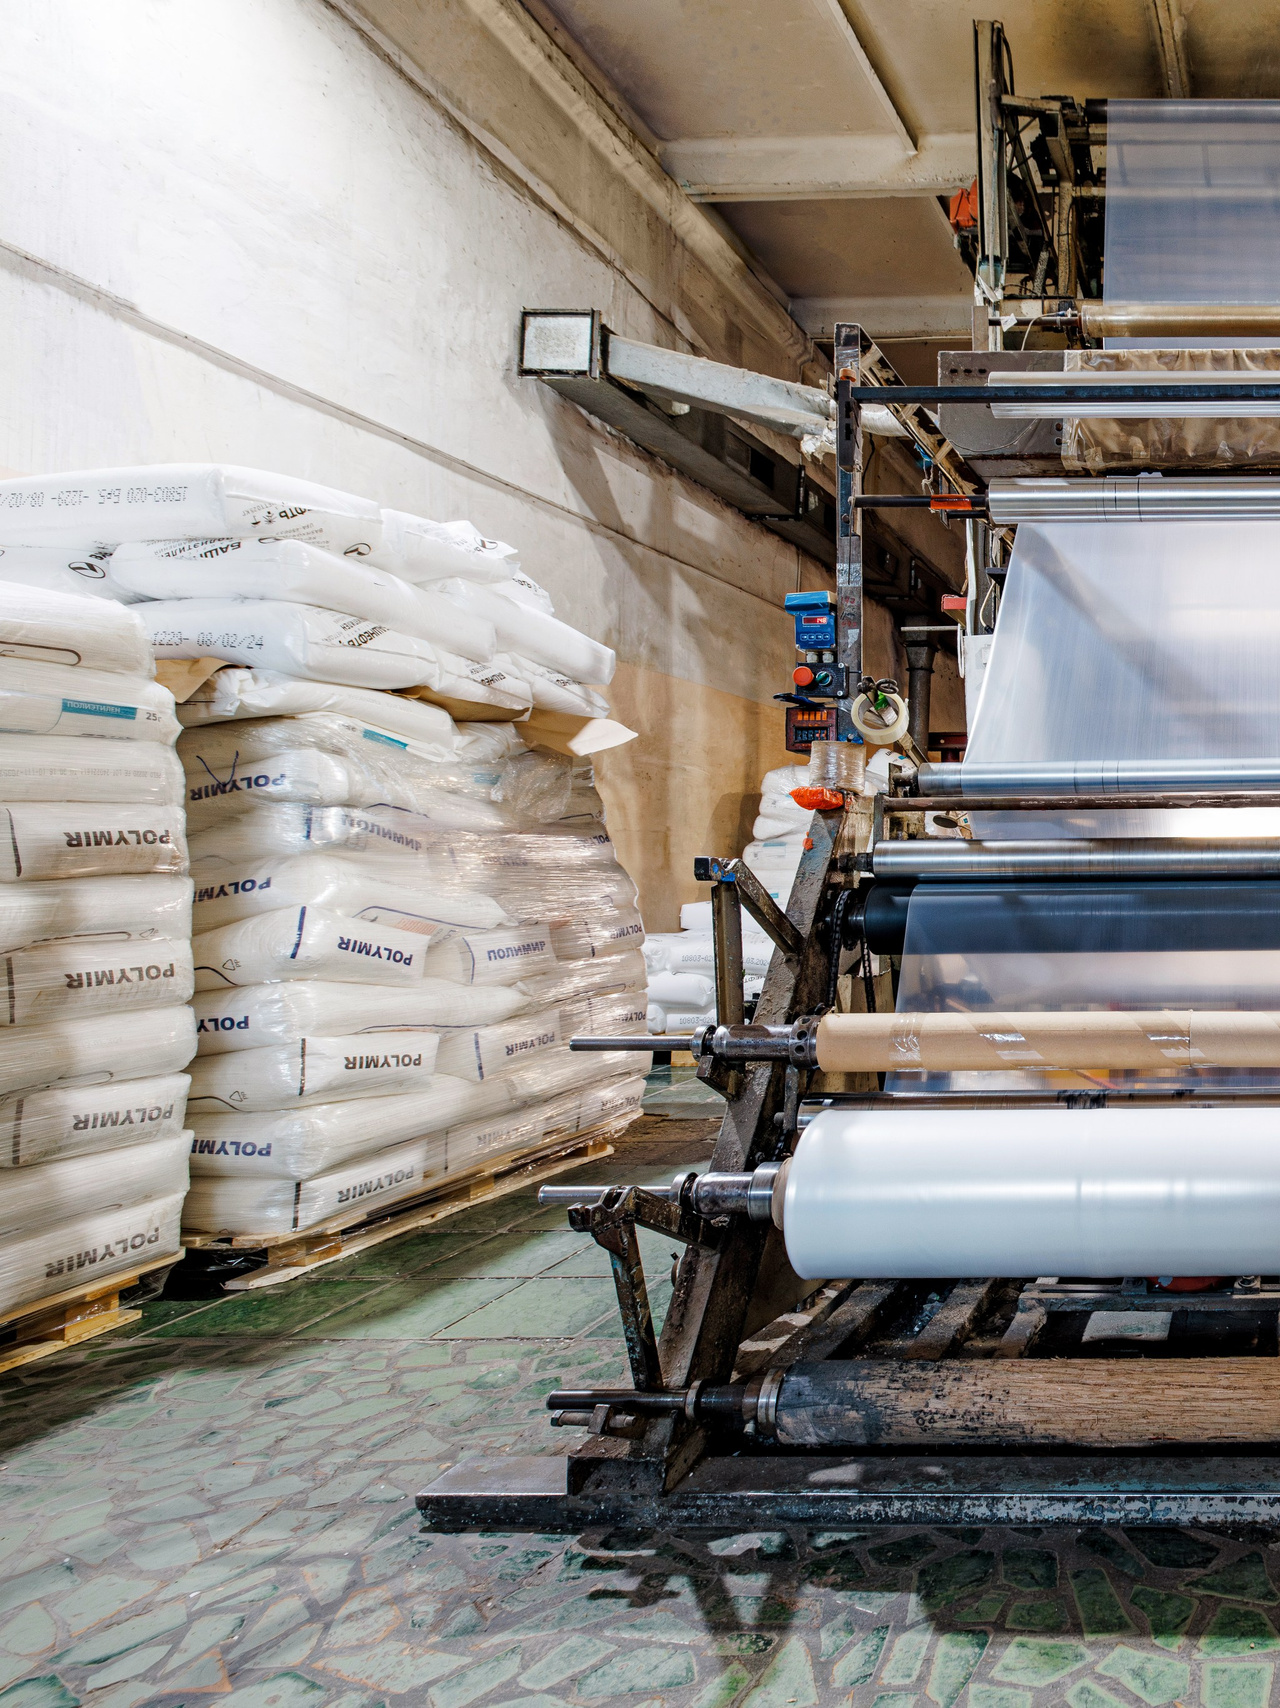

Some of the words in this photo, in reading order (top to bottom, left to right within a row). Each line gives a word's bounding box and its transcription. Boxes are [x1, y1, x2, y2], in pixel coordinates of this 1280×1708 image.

[126, 486, 188, 504] 15803-020
[196, 631, 264, 651] 08/02/24
[66, 700, 121, 714] ПОЛИЭТИЛЕН
[189, 774, 287, 801] POLYMIR
[63, 829, 172, 848] POLYMIR
[337, 936, 414, 967] POLYMIR
[487, 940, 547, 962] ПОЛИМИР
[64, 963, 175, 990] POLYMIR
[344, 1053, 422, 1070] POLYMIR
[72, 1104, 174, 1131] POLYMIR
[337, 1166, 415, 1204] POLYMIR
[44, 1226, 160, 1278] POLYMIR
